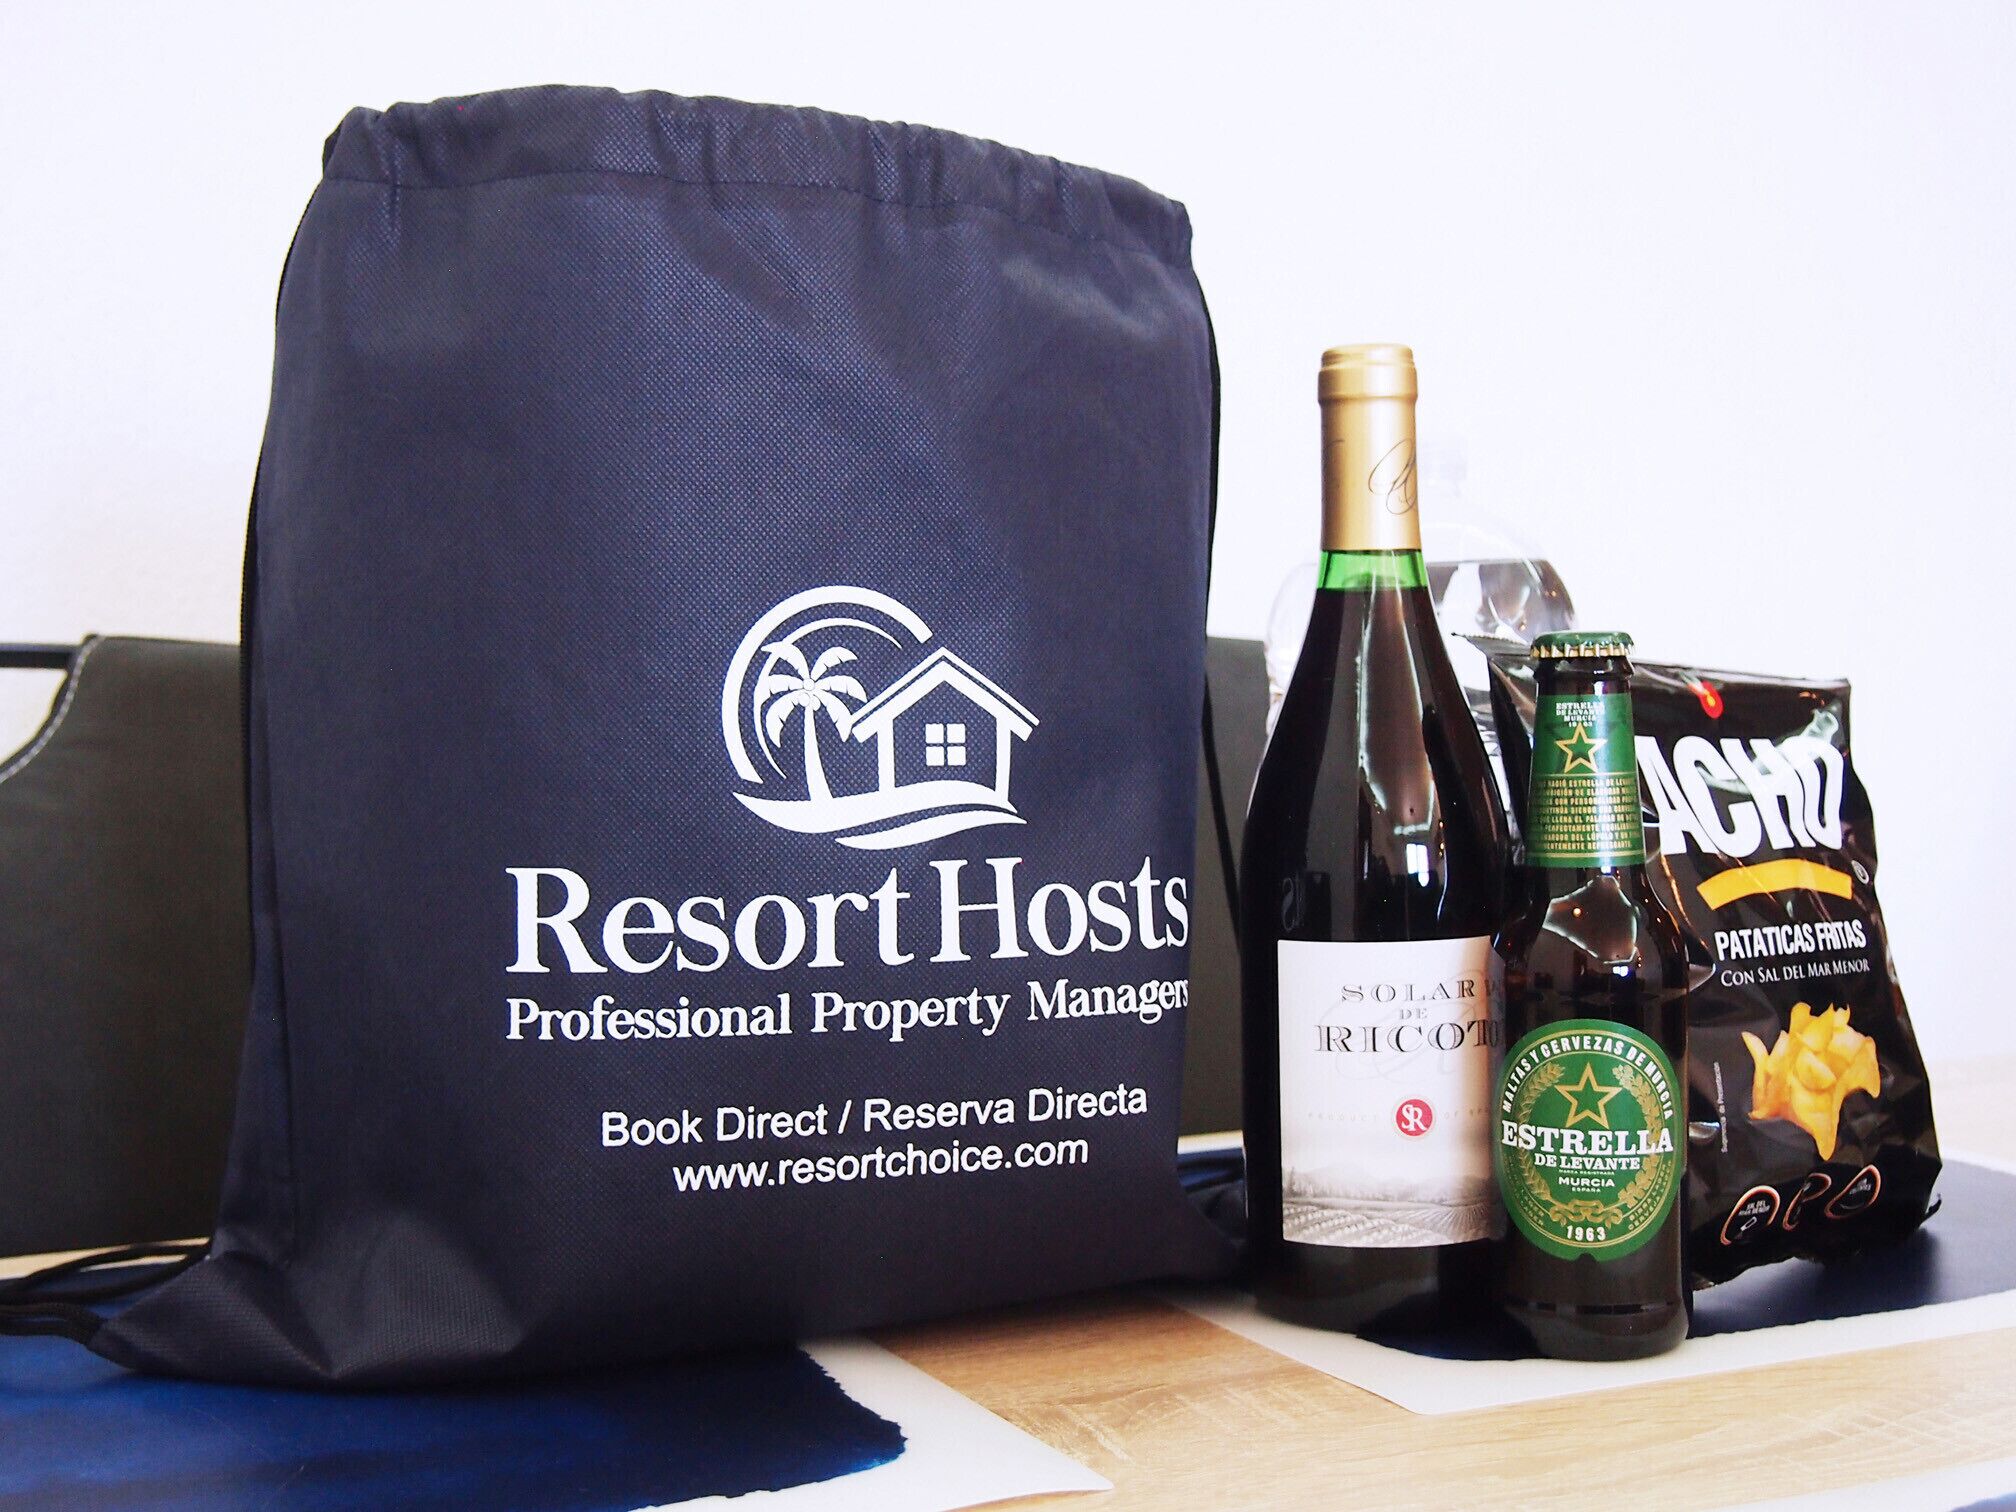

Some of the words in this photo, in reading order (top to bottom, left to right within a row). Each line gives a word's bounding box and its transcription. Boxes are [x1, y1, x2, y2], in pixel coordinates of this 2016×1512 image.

[1634, 735, 1844, 857] ACHO
[506, 867, 913, 973] Resort
[929, 856, 1189, 962] Hosts
[1714, 922, 1816, 962] PATATICAS
[1814, 919, 1868, 952] FRITAS
[1341, 979, 1476, 1002] SOLAR
[1721, 969, 1755, 987] CON
[1757, 967, 1781, 984] SAL
[1783, 963, 1806, 980] DEL
[1807, 961, 1834, 977] MAR
[1832, 957, 1871, 976] MENOR
[506, 993, 792, 1041] Professional
[811, 988, 1012, 1042] Property
[1400, 1007, 1428, 1020] DE
[1502, 1058, 1531, 1114] MALTAS
[1530, 1049, 1540, 1064] Y
[1540, 1035, 1624, 1058] CERVEZAS
[1625, 1046, 1647, 1067] DE
[1643, 1060, 1674, 1120] MURCIA
[602, 1109, 703, 1147] Book
[717, 1104, 828, 1142] Direct
[838, 1100, 852, 1135] /
[865, 1098, 1015, 1133] Reserva
[1028, 1083, 1148, 1122] Directa
[1501, 1119, 1674, 1156] ESTRELLA
[673, 1136, 1089, 1192] www.resortchoice.com
[1534, 1153, 1557, 1168] DE
[1560, 1156, 1641, 1171] LEVANTE
[1558, 1176, 1616, 1187] MURCIA
[1567, 1225, 1606, 1241] 1963
